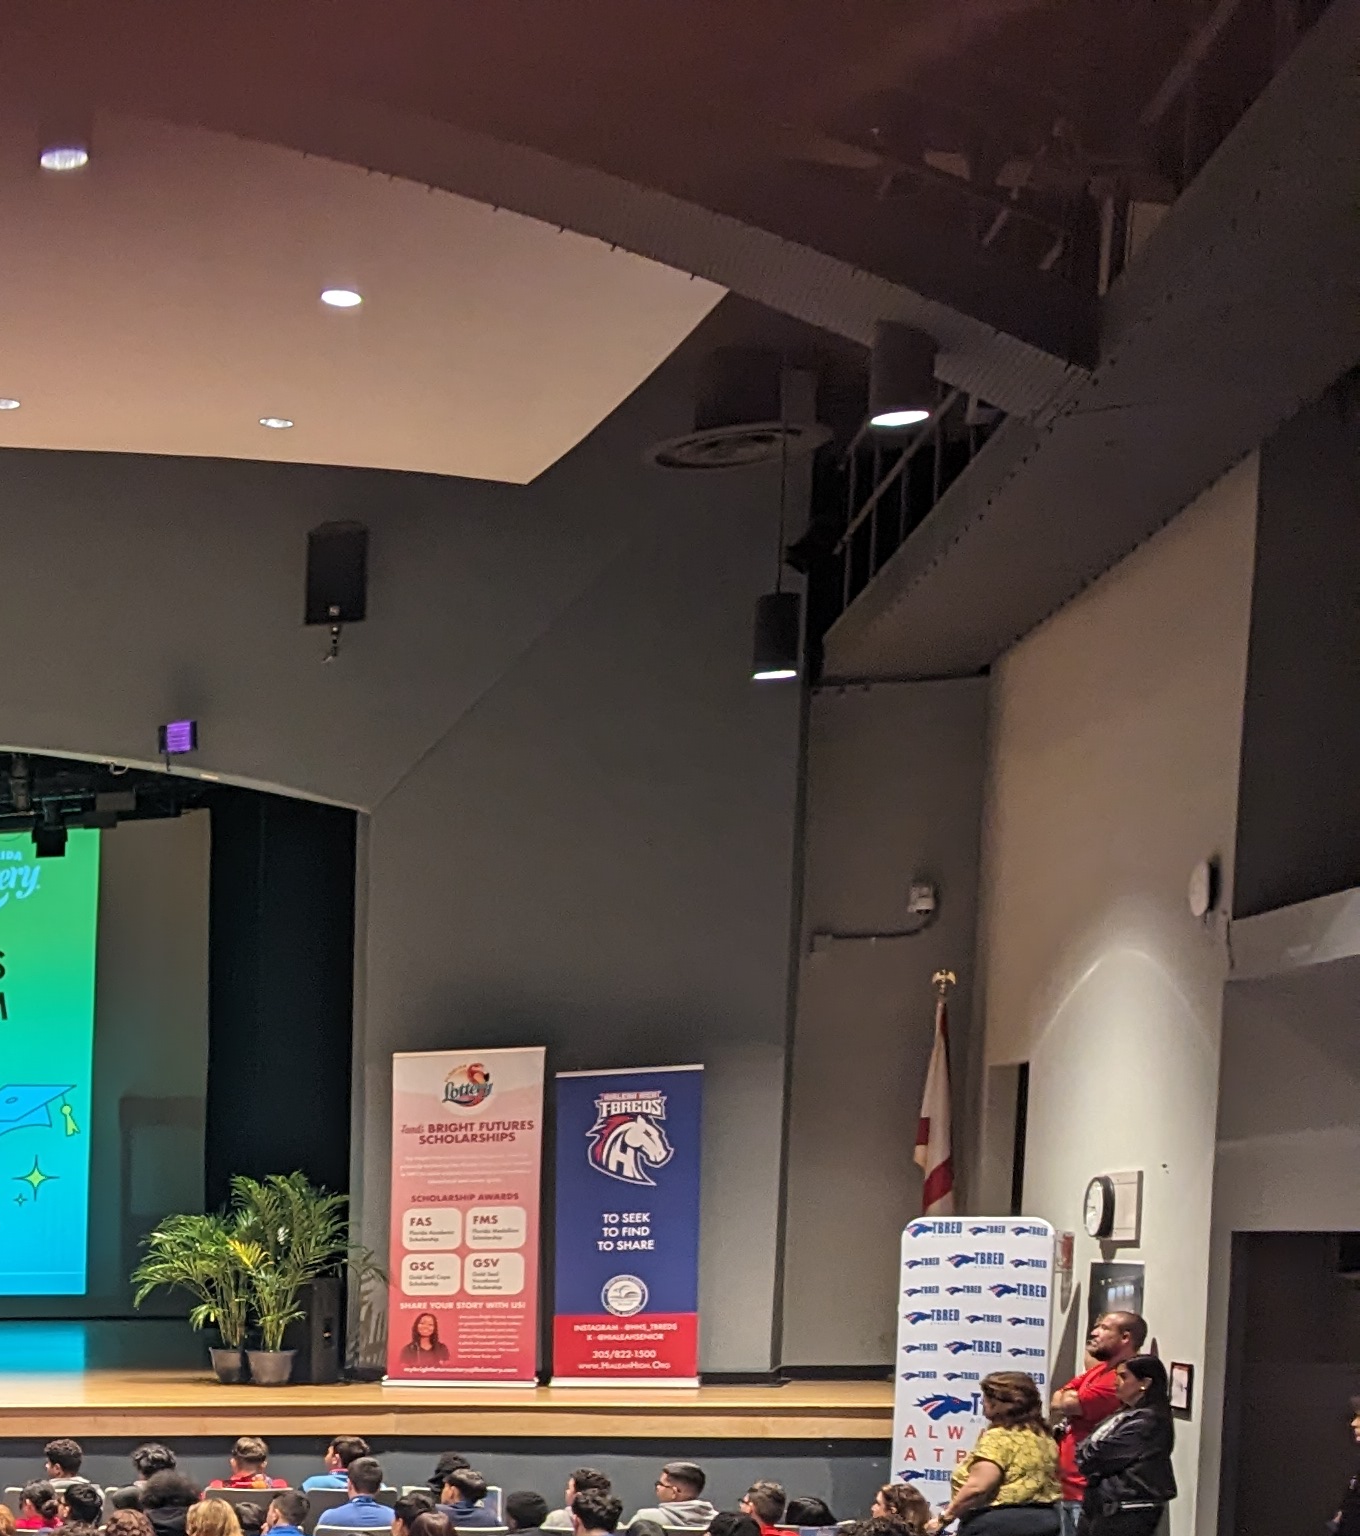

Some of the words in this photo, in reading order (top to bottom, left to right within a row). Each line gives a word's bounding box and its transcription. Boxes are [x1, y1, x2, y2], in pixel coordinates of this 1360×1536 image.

[428, 1122, 475, 1133] BRIGHT
[479, 1120, 534, 1132] FUTURES
[419, 1132, 516, 1145] SCHOLARSHIPS
[411, 1194, 476, 1202] SCHOLARSHIP
[410, 1217, 432, 1226] FAS
[473, 1215, 498, 1224] FMS
[602, 1213, 619, 1224] TO
[622, 1212, 651, 1223] SEEK
[602, 1227, 619, 1237] TO
[622, 1226, 650, 1237] FIND
[933, 1222, 962, 1234] TBRED
[597, 1241, 614, 1251] TO
[616, 1240, 654, 1250] SHARE
[473, 1258, 499, 1268] GSV
[974, 1252, 1004, 1265] TBRED
[410, 1262, 434, 1271] GSC
[1017, 1284, 1047, 1298] TBRED
[931, 1309, 960, 1321] TBRED
[972, 1340, 1002, 1354] TBRED
